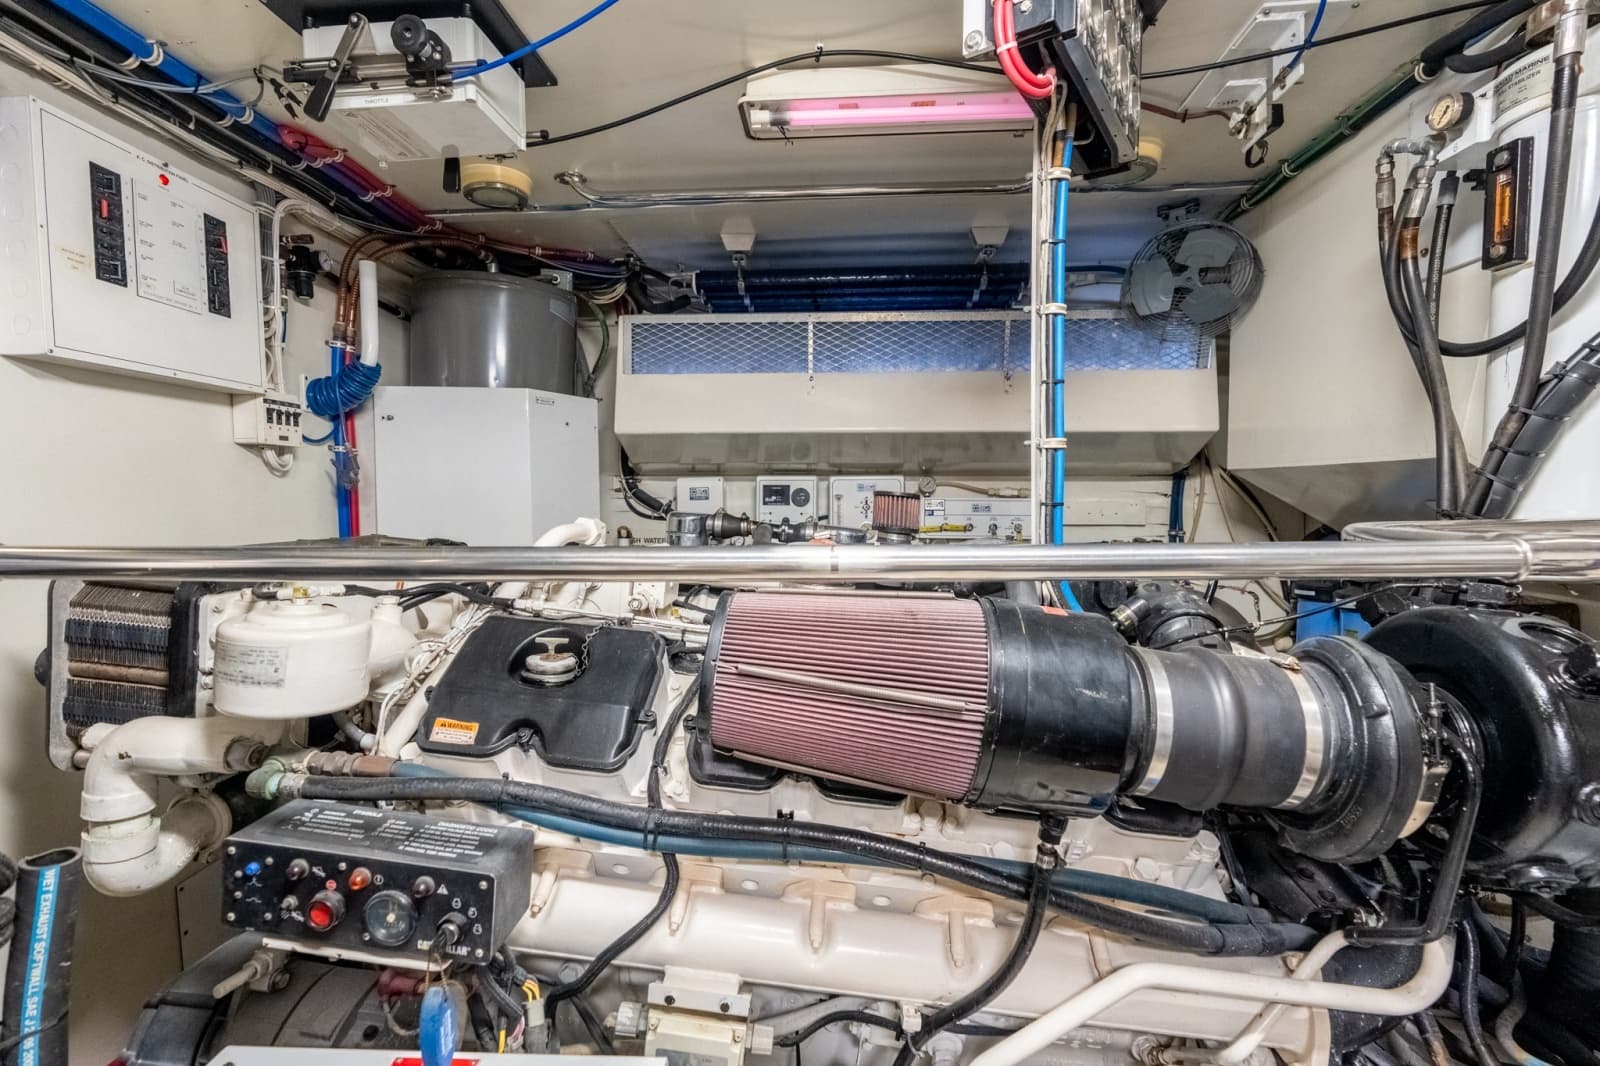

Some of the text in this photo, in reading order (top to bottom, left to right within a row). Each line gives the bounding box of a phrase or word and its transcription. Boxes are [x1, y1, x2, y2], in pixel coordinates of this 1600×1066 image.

[1515, 55, 1550, 75] MARINE
[364, 97, 389, 105] THROTTLE
[42, 868, 56, 891] WET
[35, 893, 52, 939] EXHAUST
[27, 941, 46, 995] SOFTWALL
[25, 996, 39, 1017] SAE
